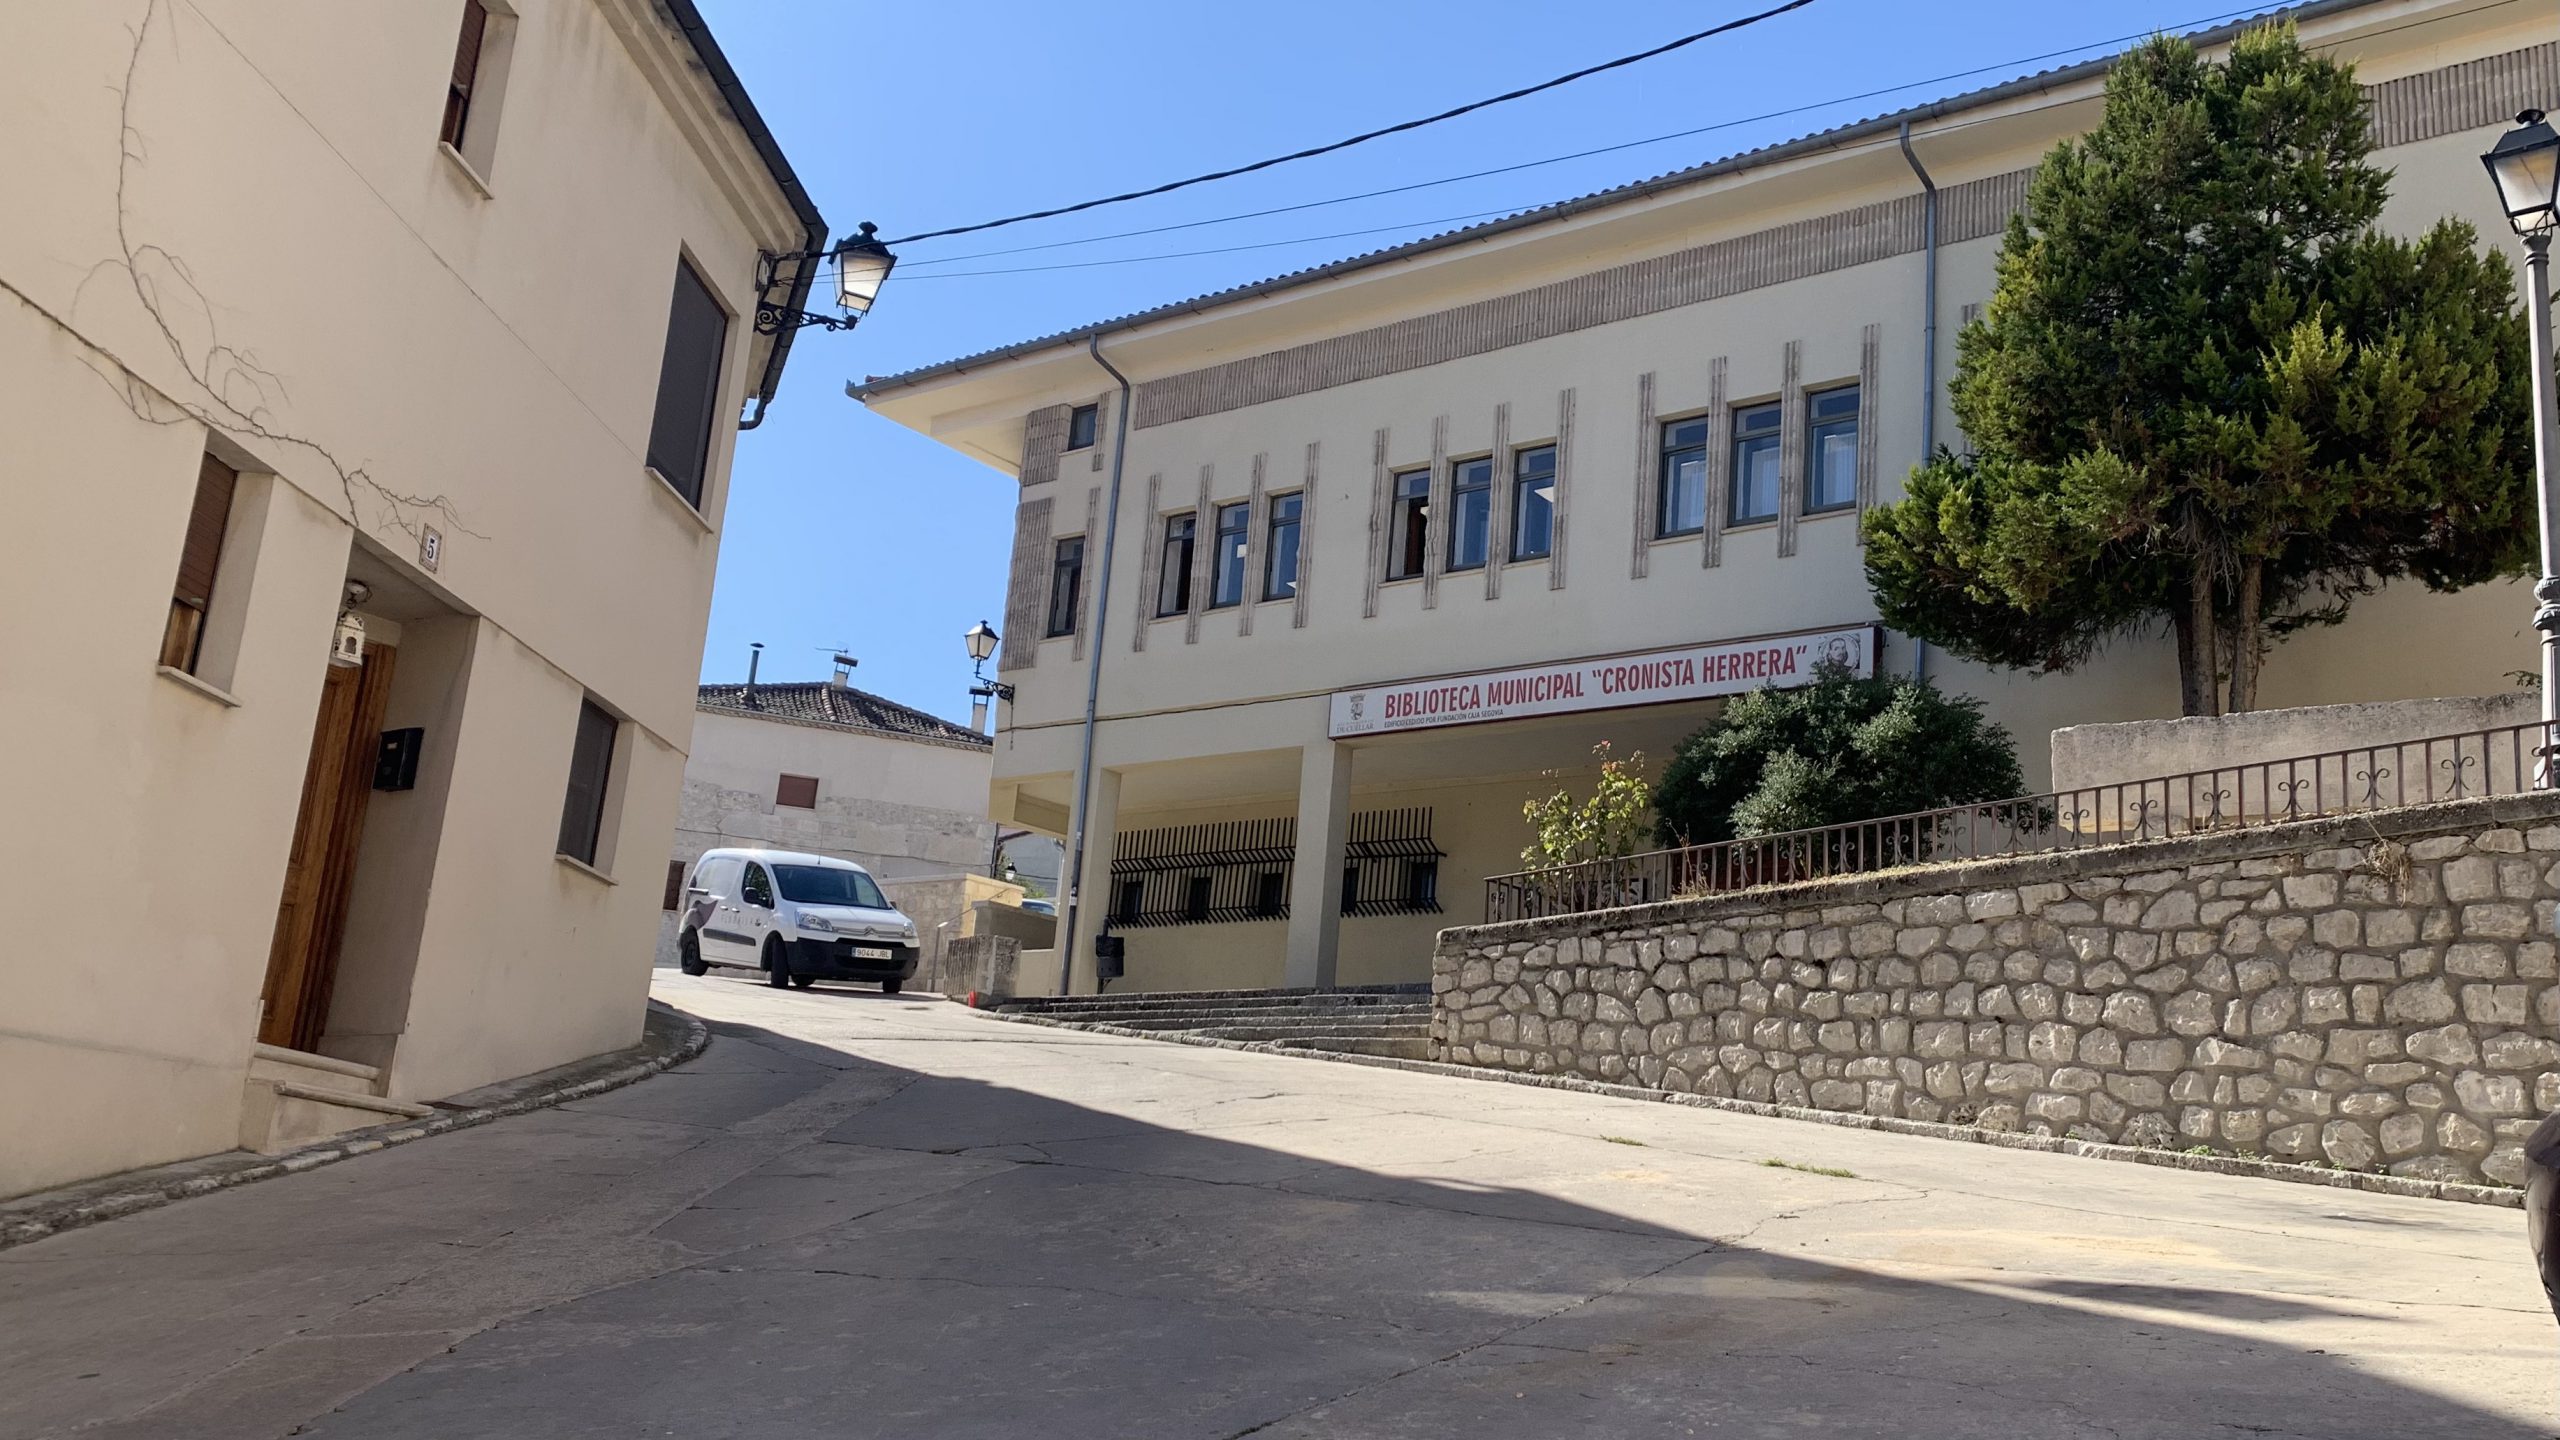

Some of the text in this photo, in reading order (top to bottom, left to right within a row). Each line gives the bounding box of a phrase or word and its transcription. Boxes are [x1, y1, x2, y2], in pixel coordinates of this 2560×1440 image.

[1384, 684, 1481, 719] BIBLIOTECA
[1487, 671, 1584, 707] MUNICIPAL
[1384, 718, 1405, 728] EDIFICIO
[1405, 717, 1425, 726] CEDIDO
[1426, 716, 1436, 724] POR
[1468, 711, 1480, 720] CAJA
[1481, 708, 1504, 718] SEGOVIA
[856, 948, 874, 957] 9044
